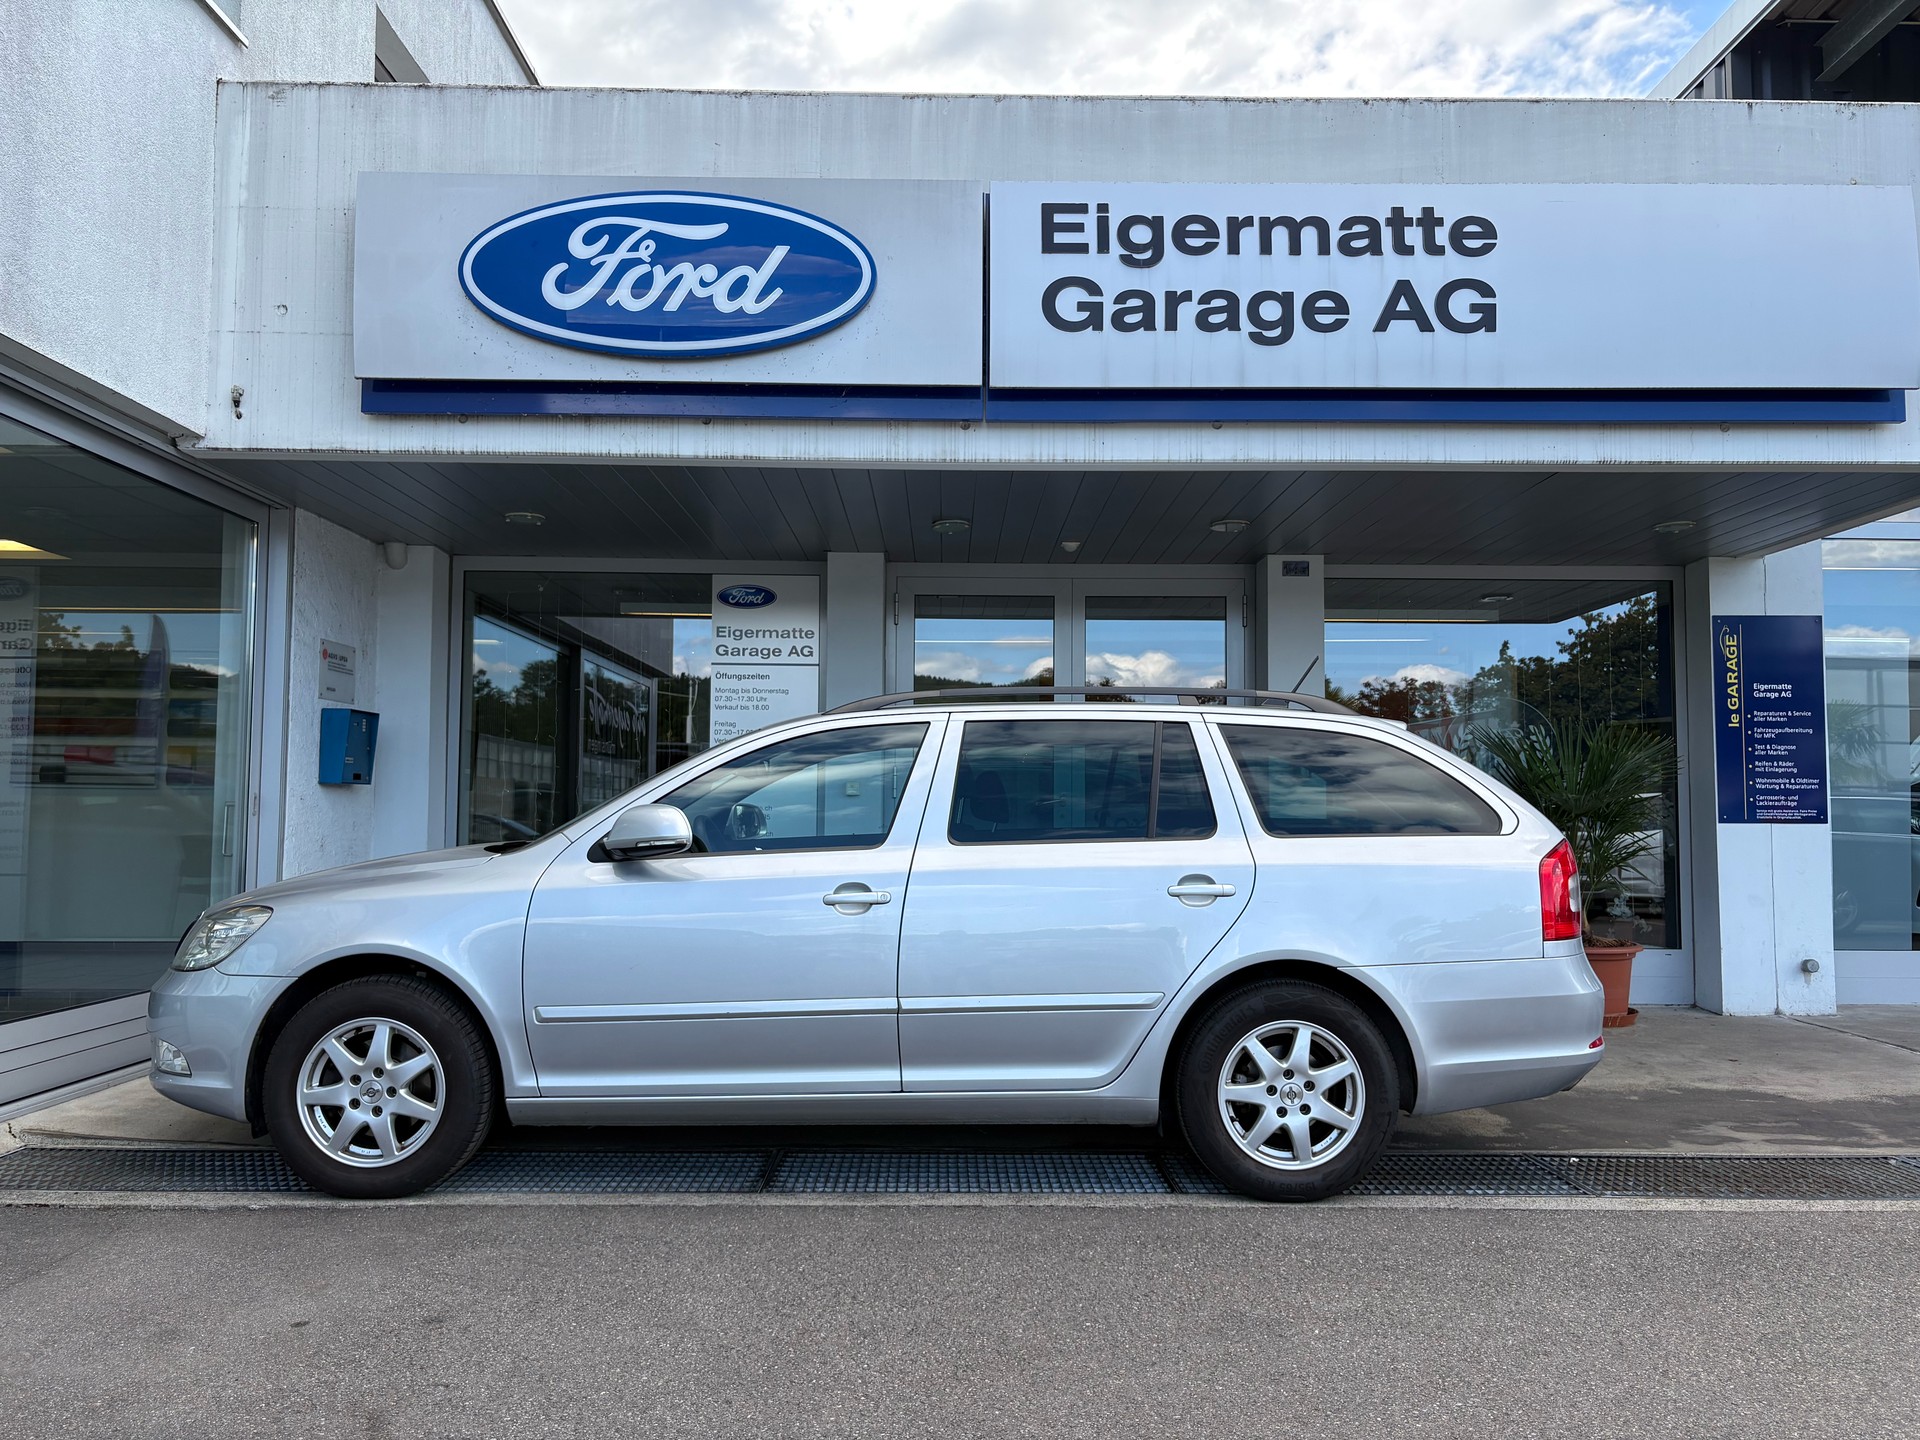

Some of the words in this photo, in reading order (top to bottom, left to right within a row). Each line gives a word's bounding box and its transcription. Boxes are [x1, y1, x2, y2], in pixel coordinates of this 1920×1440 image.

[1041, 202, 1498, 268] Eigermatte
[541, 216, 790, 314] Ford
[1041, 276, 1350, 346] Garage
[1372, 278, 1497, 333] AG
[728, 588, 765, 604] Ford
[716, 626, 816, 641] Eigermatte
[716, 644, 782, 660] Garage
[788, 645, 814, 658] AG
[1726, 634, 1739, 710] GARAGE
[1753, 683, 1792, 691] Eigermatte
[1753, 691, 1779, 699] Garage
[1728, 714, 1740, 727] le
